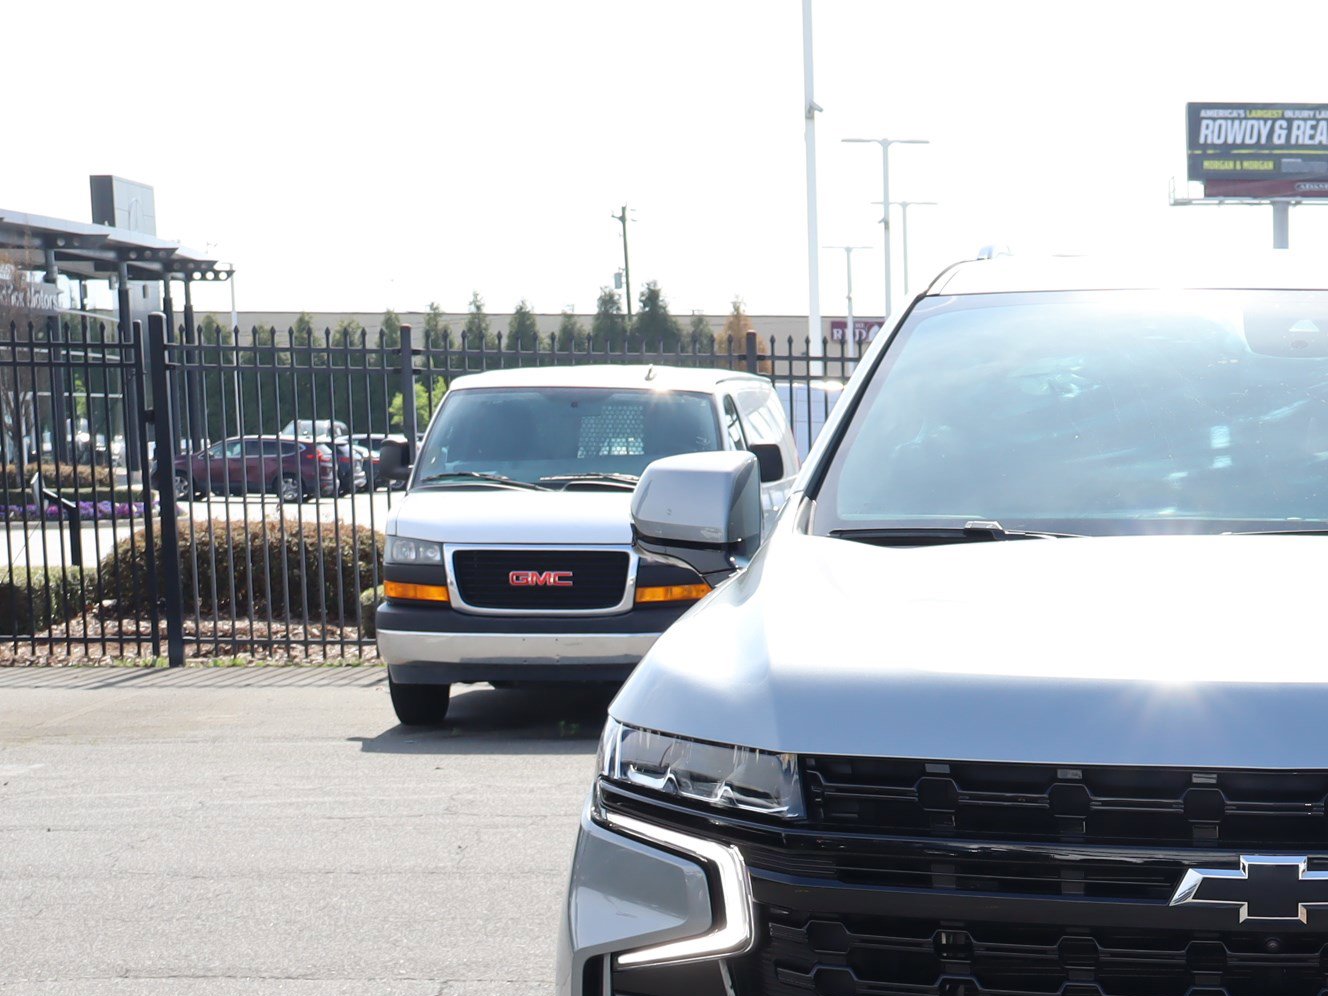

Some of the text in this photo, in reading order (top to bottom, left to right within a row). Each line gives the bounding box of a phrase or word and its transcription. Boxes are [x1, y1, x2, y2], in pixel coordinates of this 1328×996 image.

[1247, 109, 1282, 118] LARGEST
[1199, 119, 1272, 144] ROWDY
[1273, 119, 1288, 144] &
[509, 571, 573, 586] GMC
